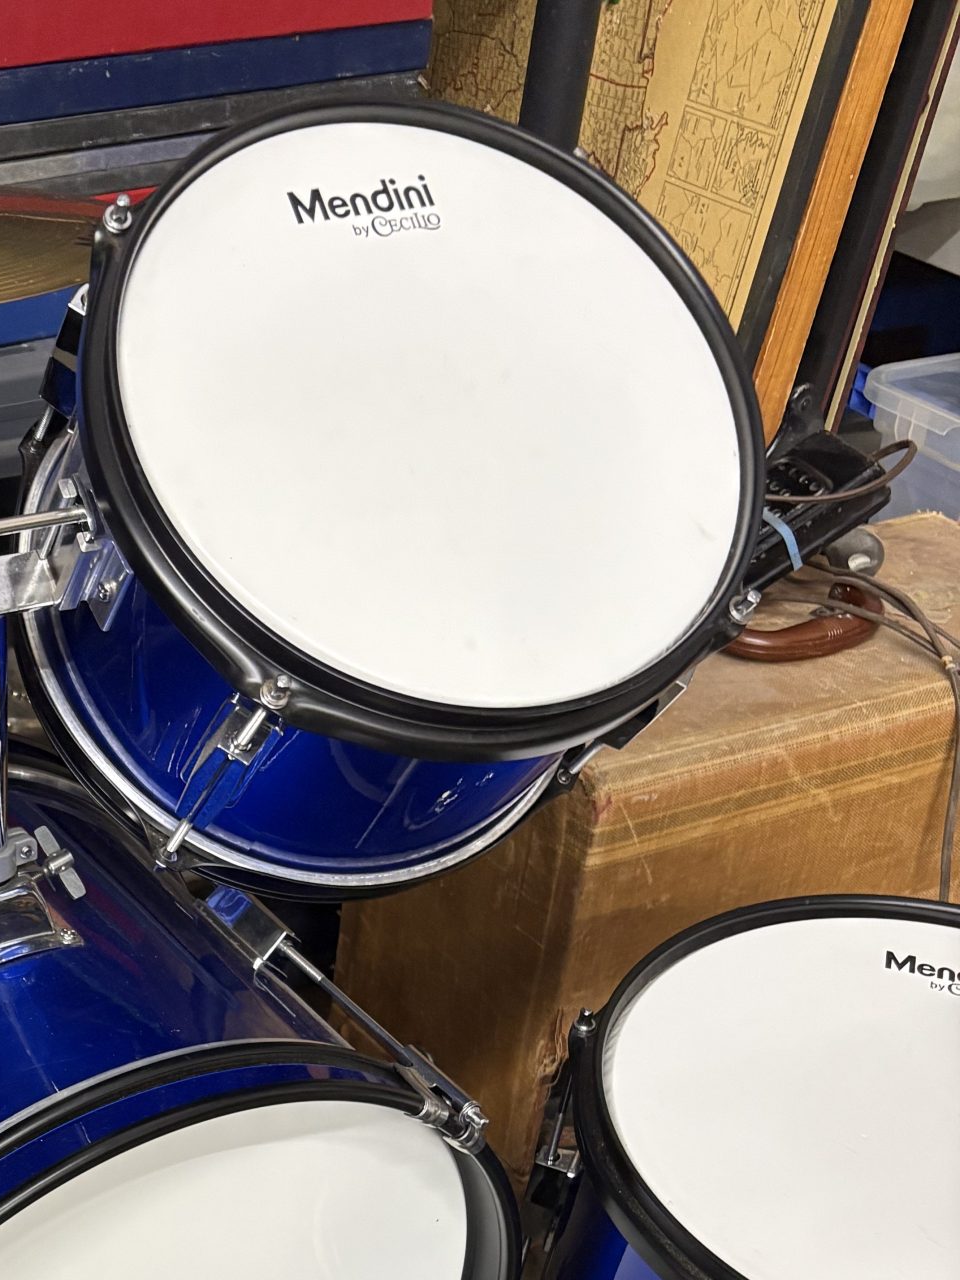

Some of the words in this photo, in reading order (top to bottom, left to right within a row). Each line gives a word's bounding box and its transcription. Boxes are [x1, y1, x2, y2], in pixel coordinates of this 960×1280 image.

[287, 174, 436, 225] Mendini
[352, 225, 370, 238] by
[885, 950, 960, 982] Men
[930, 981, 945, 991] by
